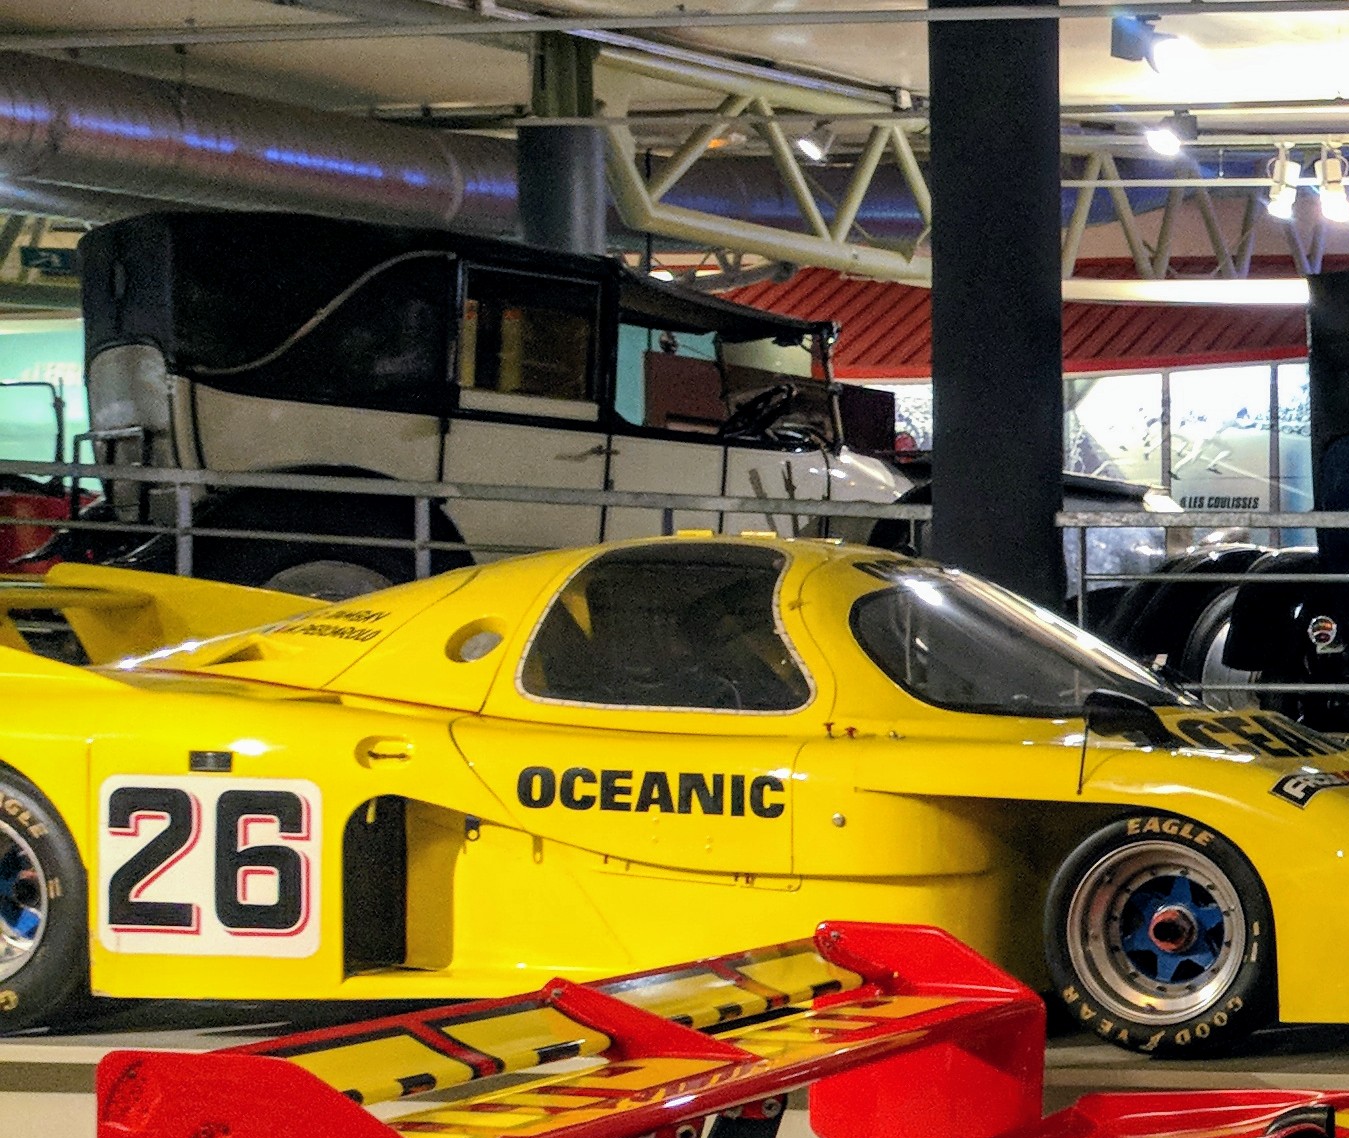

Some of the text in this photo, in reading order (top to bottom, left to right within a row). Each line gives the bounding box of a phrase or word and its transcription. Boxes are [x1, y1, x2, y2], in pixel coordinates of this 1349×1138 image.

[1207, 497, 1259, 509] COULISSES
[516, 765, 786, 819] OCEANIC
[0, 794, 49, 839] GLE
[1127, 816, 1216, 847] EAGLE
[107, 786, 312, 936] 26
